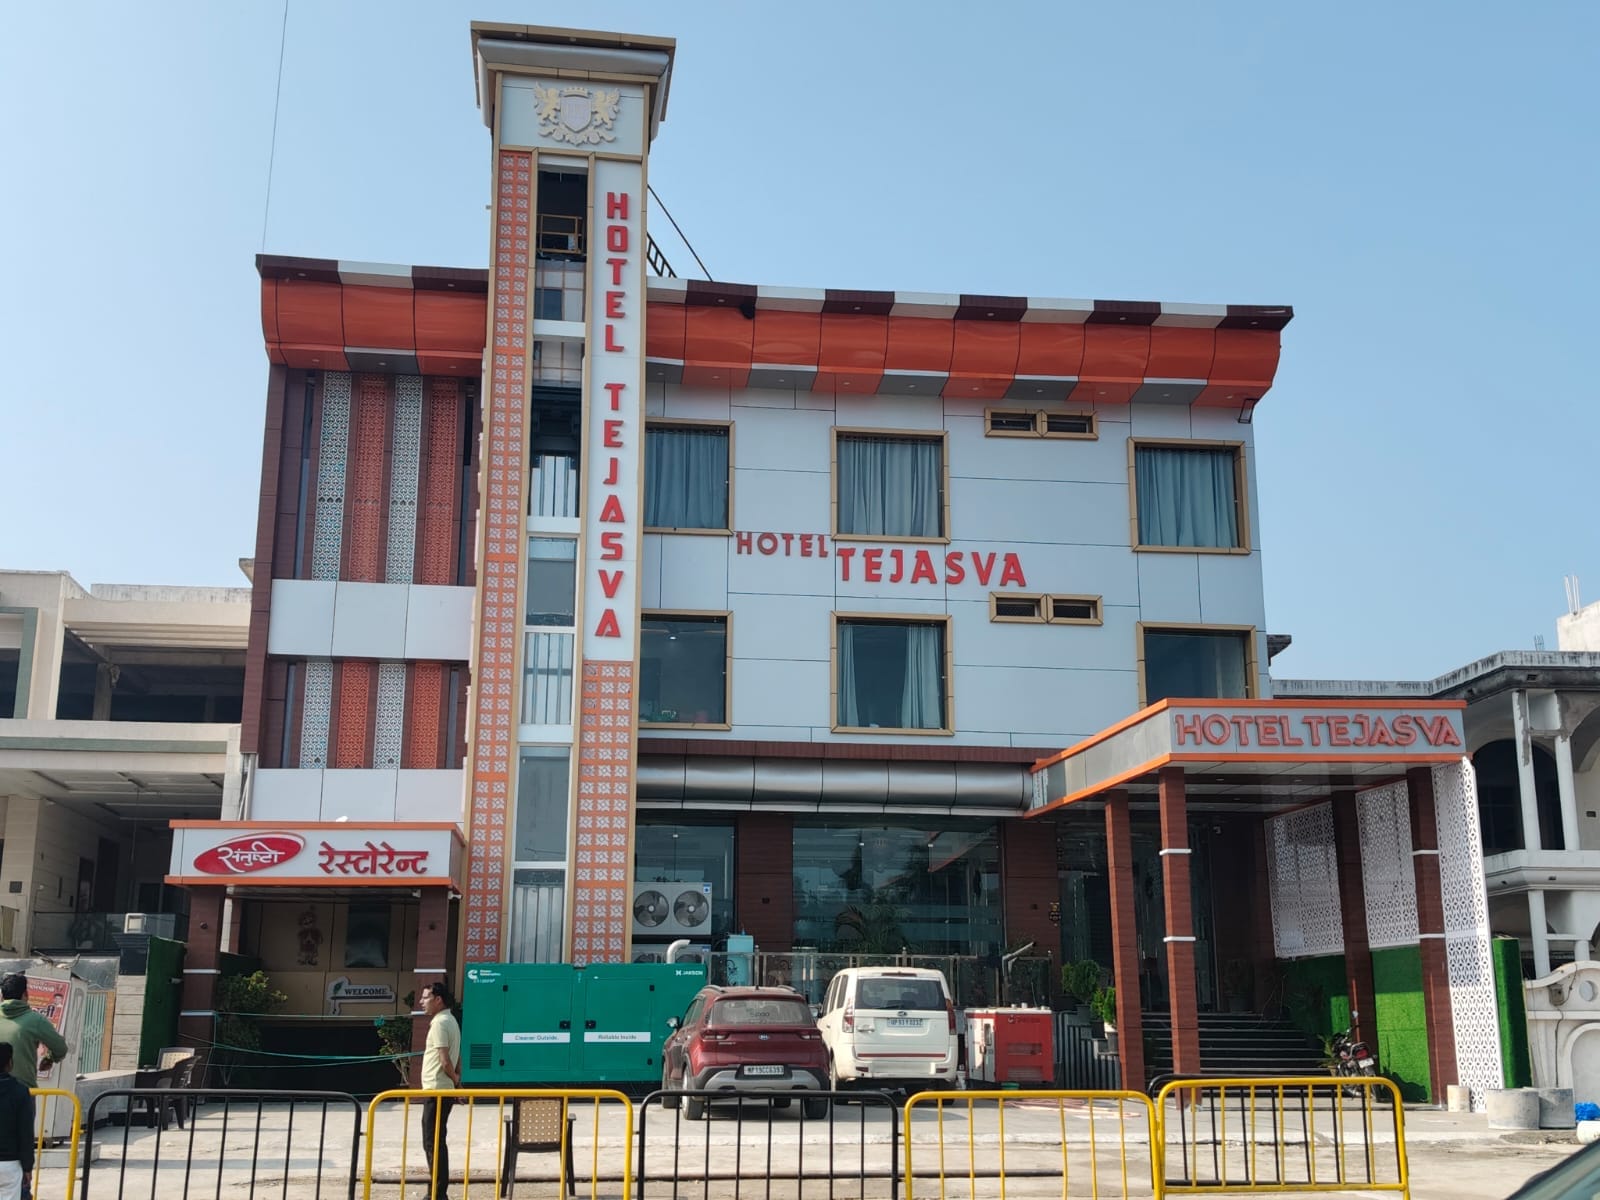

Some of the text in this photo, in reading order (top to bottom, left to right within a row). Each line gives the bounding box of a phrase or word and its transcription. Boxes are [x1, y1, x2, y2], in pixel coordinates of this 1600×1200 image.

[595, 191, 629, 638] HOTEL TEJASVA
[735, 531, 828, 558] HOTEL
[836, 547, 1027, 587] TEJASVA
[1174, 713, 1462, 747] HOTEL TEJASVA
[318, 840, 430, 875] रेस्टोरेन्ट
[344, 987, 388, 996] WELCOME
